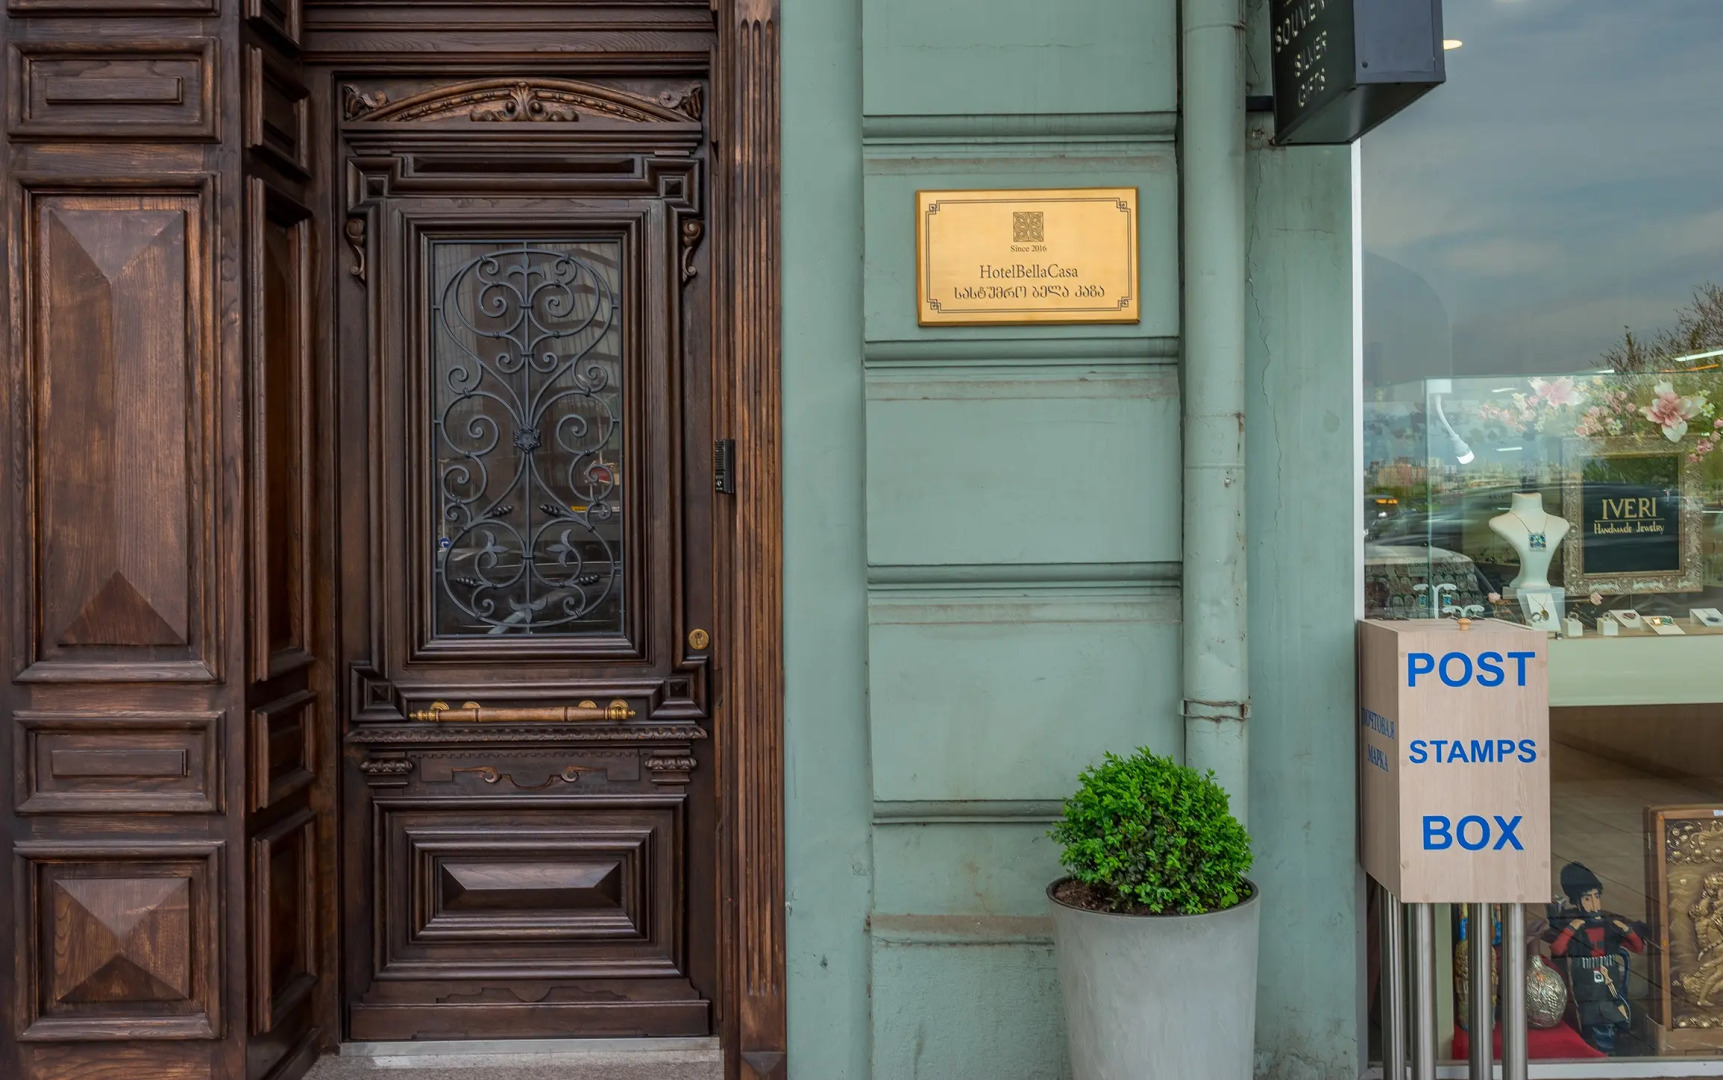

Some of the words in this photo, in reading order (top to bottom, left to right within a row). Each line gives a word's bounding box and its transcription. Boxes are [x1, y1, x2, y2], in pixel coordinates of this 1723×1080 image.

[1298, 67, 1325, 107] GIFTS
[1010, 244, 1030, 253] Since
[1031, 244, 1047, 253] 2016
[979, 263, 1079, 279] HotelBellaCasa
[954, 285, 1027, 300] სასტუმრო
[1032, 285, 1069, 298] ბელა
[1074, 285, 1105, 298] კაზა
[1602, 497, 1657, 520] IVERI
[1594, 522, 1633, 535] Handmade
[1636, 520, 1665, 535] Jewelry
[1407, 651, 1536, 688] POST
[1367, 743, 1389, 773] МАРКА
[1408, 739, 1537, 764] STAMPS
[1422, 815, 1524, 851] BOX
